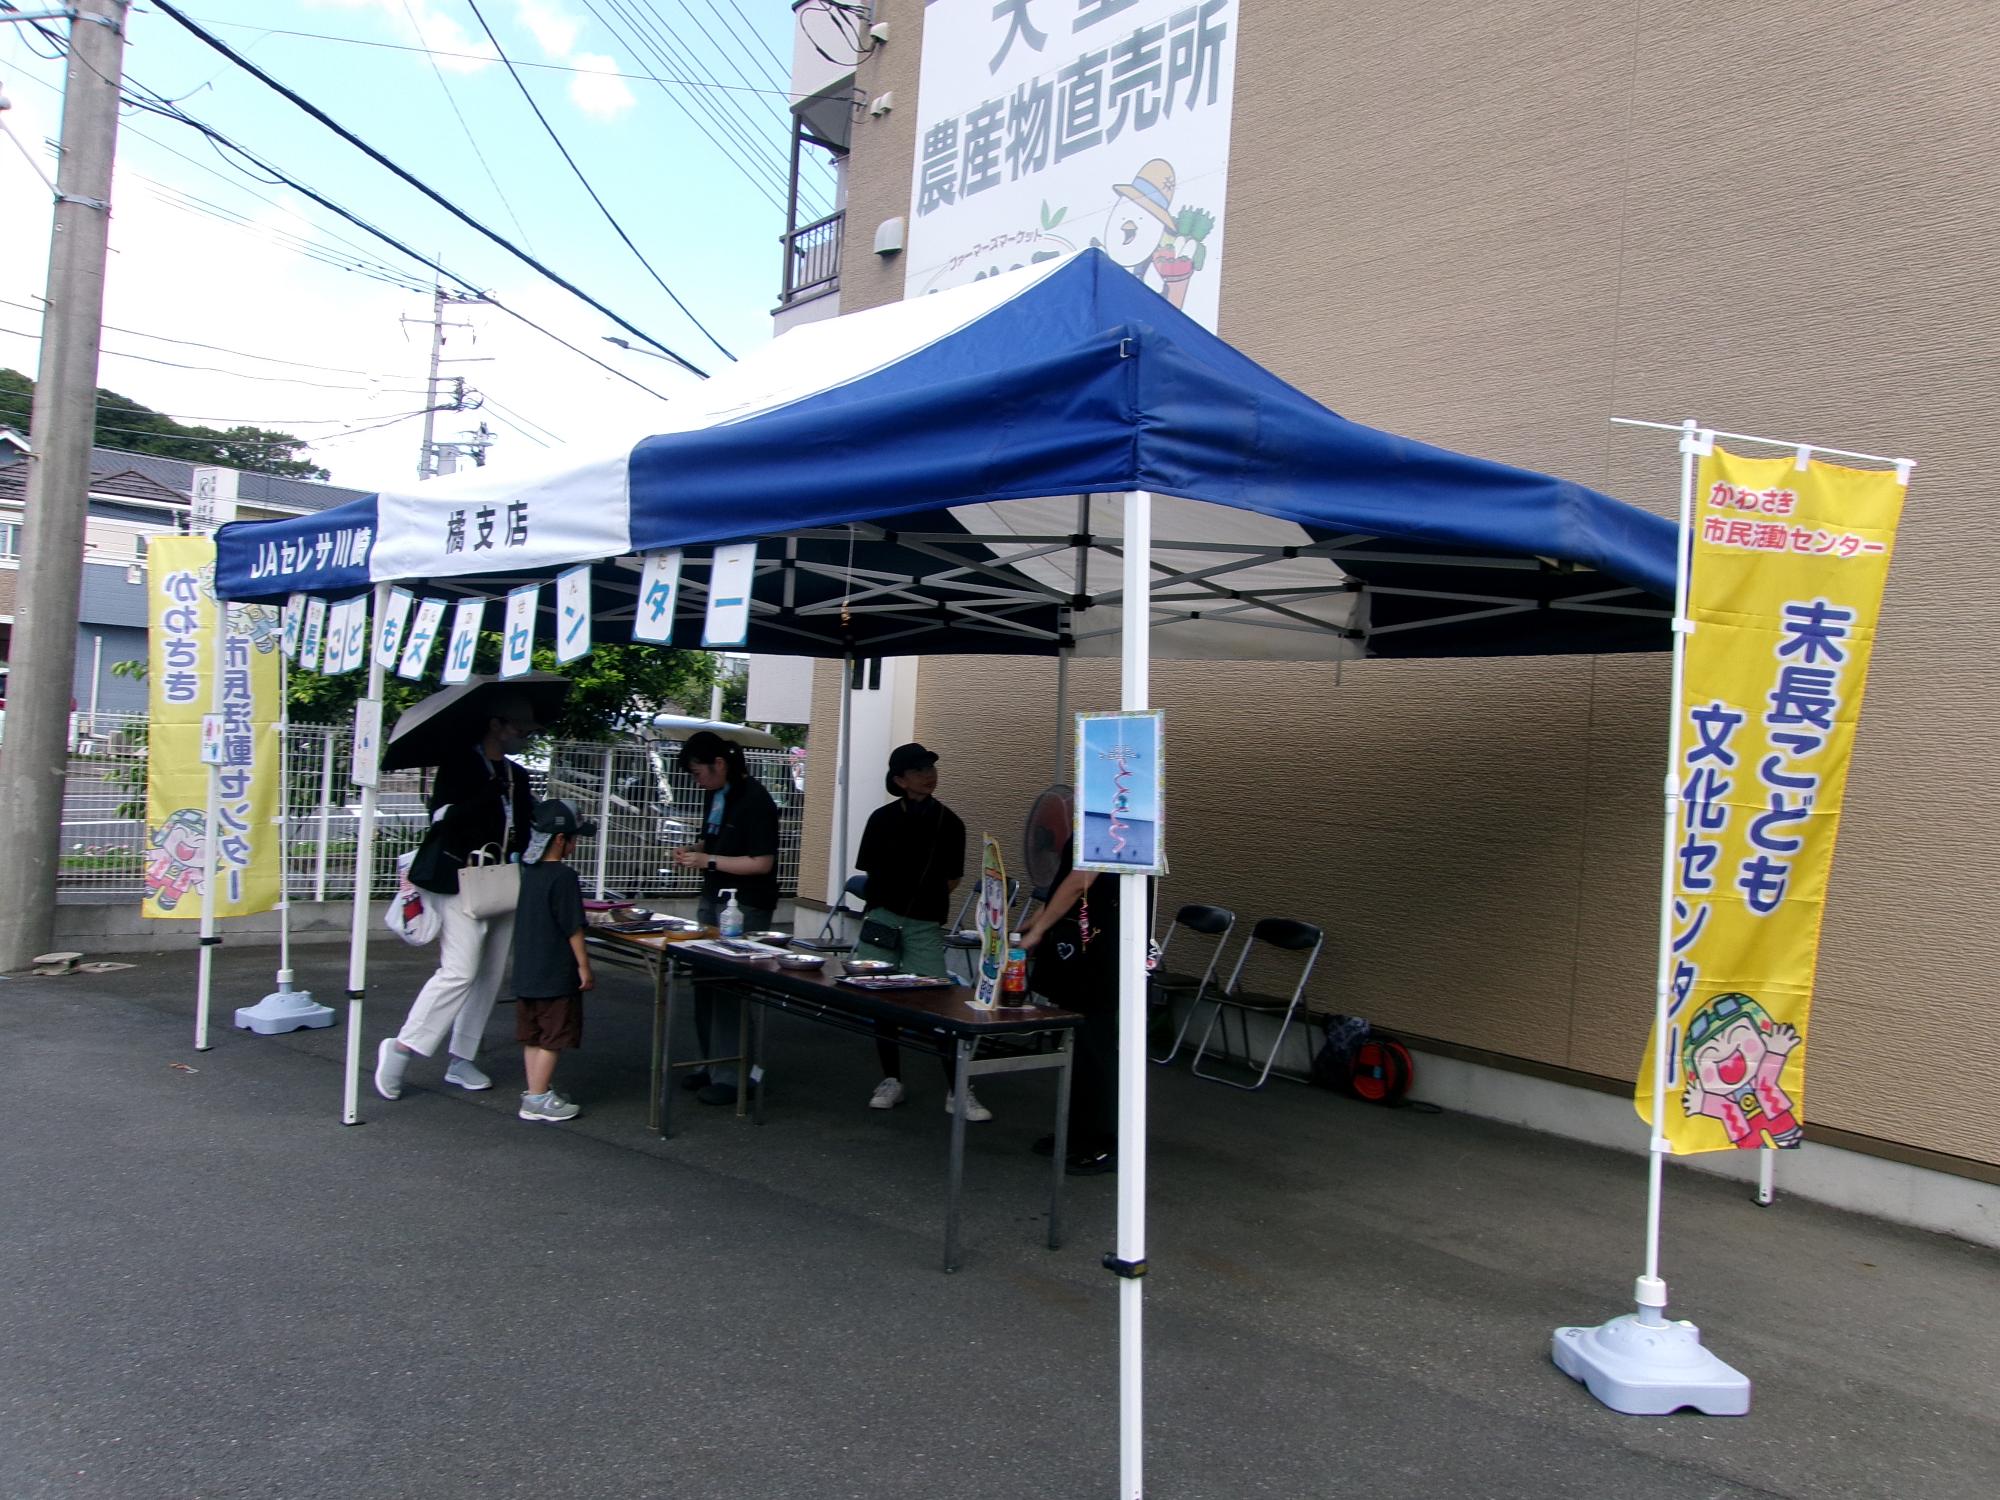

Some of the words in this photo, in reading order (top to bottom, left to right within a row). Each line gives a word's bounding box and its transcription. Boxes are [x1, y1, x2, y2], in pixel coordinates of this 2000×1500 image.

[916, 0, 1228, 217] 農産物直売所
[1711, 483, 1794, 514] かわさき
[249, 527, 372, 578] JAセレサ川崎
[446, 500, 528, 554] 橘支店
[1704, 518, 1883, 557] 市民活動センター
[1738, 602, 1851, 911] 末長こども
[1668, 703, 1743, 1084] 文化センター
